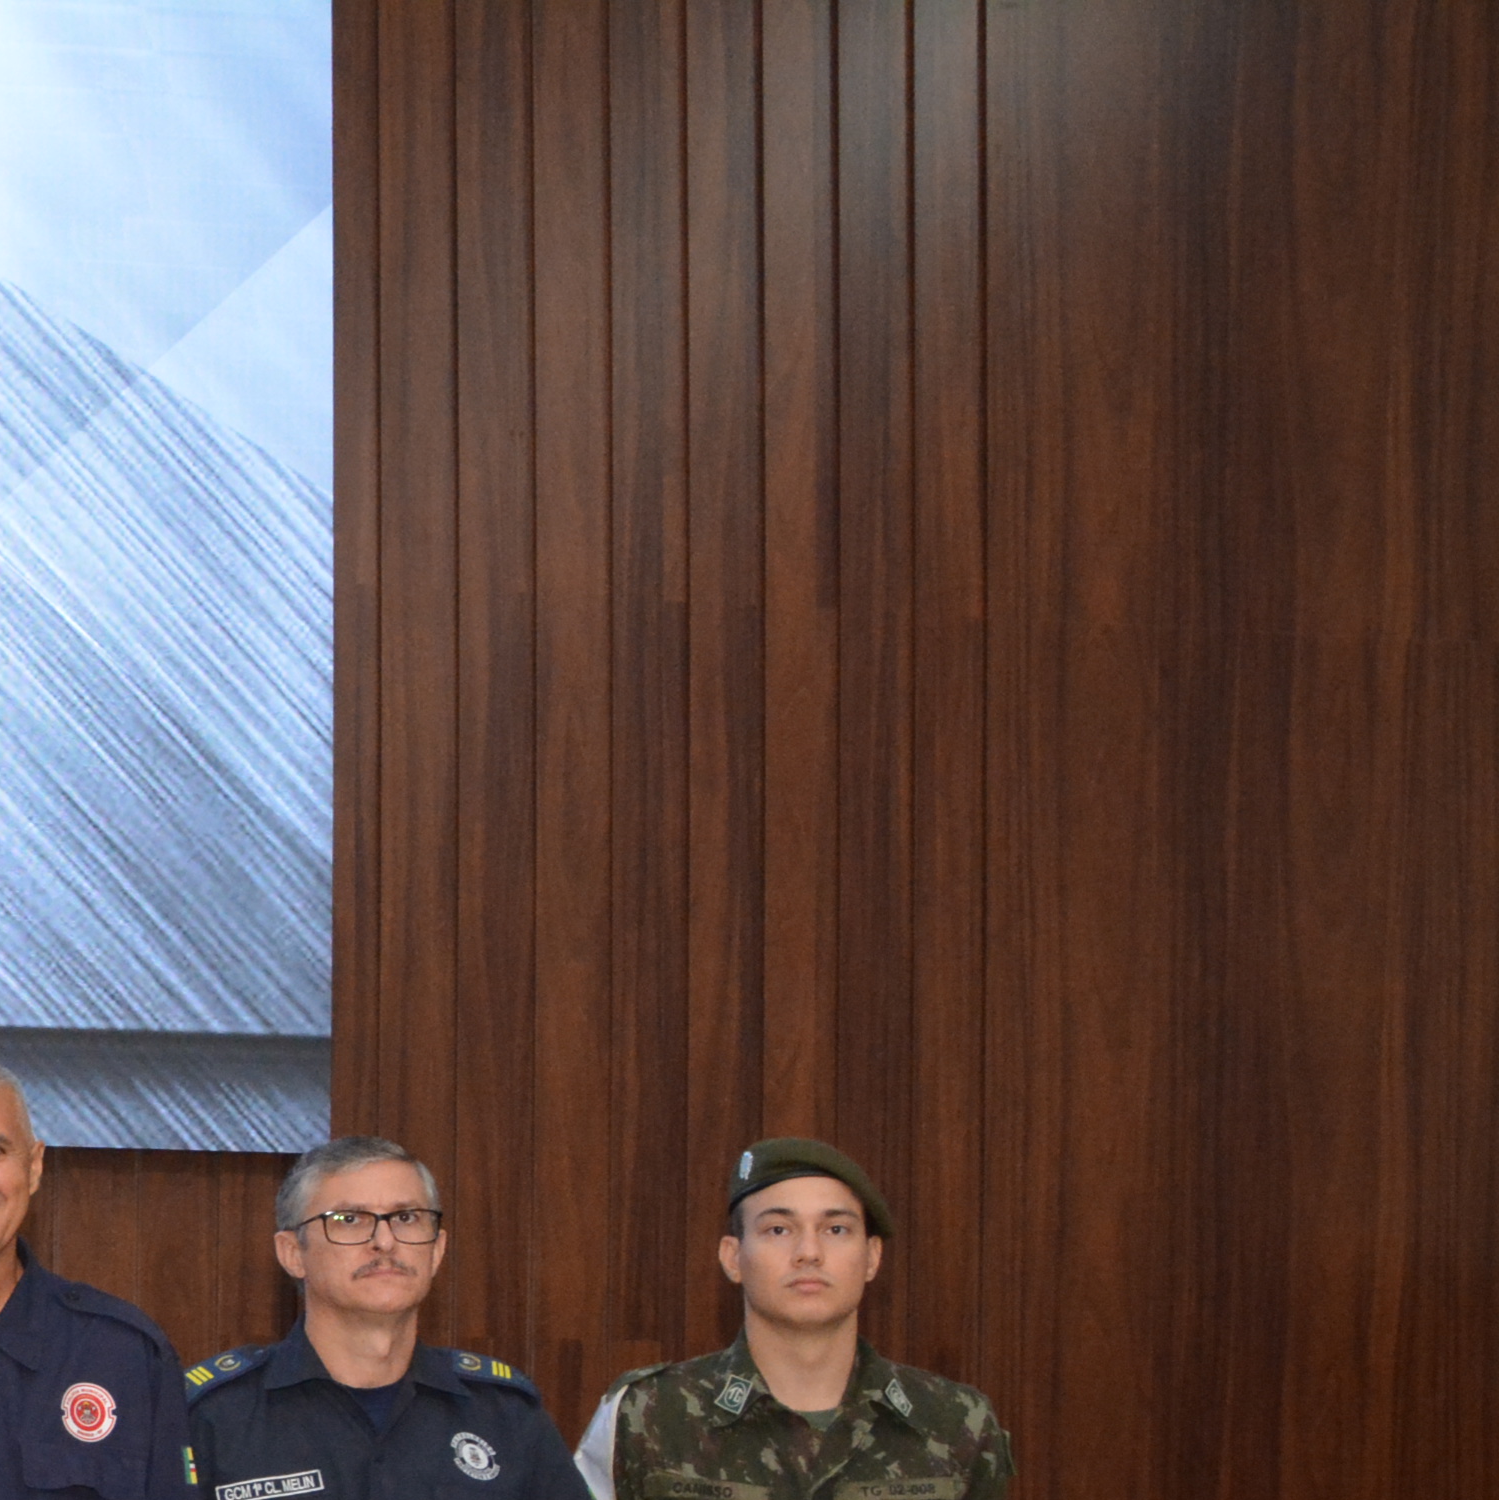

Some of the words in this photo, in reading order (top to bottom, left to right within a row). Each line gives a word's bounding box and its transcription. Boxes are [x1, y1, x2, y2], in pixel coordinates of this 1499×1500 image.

[224, 1484, 252, 1500] GCM
[281, 1475, 316, 1492] MELIN
[672, 1481, 733, 1498] CANISSO
[860, 1485, 882, 1497] TG
